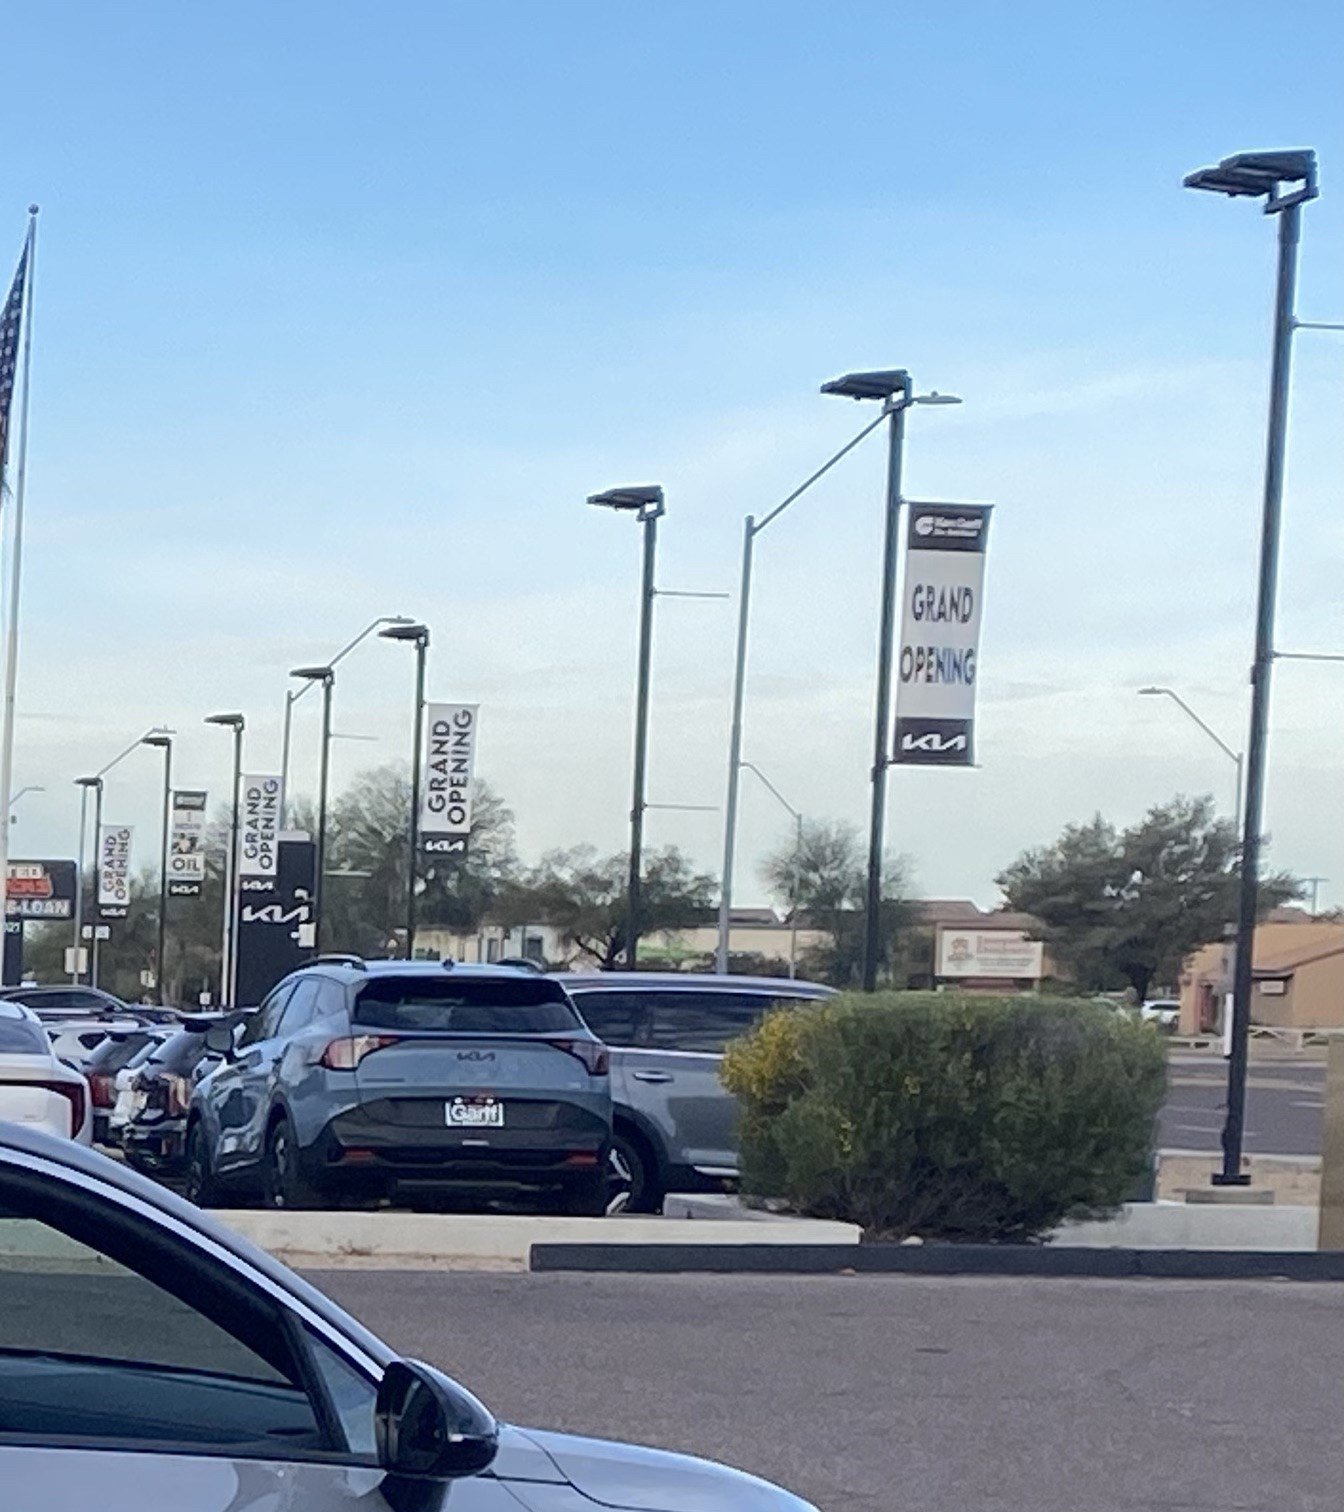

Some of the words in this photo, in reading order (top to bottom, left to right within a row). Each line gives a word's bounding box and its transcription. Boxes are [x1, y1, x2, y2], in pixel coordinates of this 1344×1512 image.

[912, 584, 973, 623] GRAND
[900, 646, 976, 684] OPENING
[902, 733, 966, 750] KIA
[428, 720, 450, 813] GRAND
[447, 709, 472, 825] OPENING
[244, 787, 261, 859] GRAND
[259, 779, 278, 869] OPENING
[102, 836, 117, 892] GRAND
[172, 858, 200, 871] OIL
[242, 905, 309, 921] KIA
